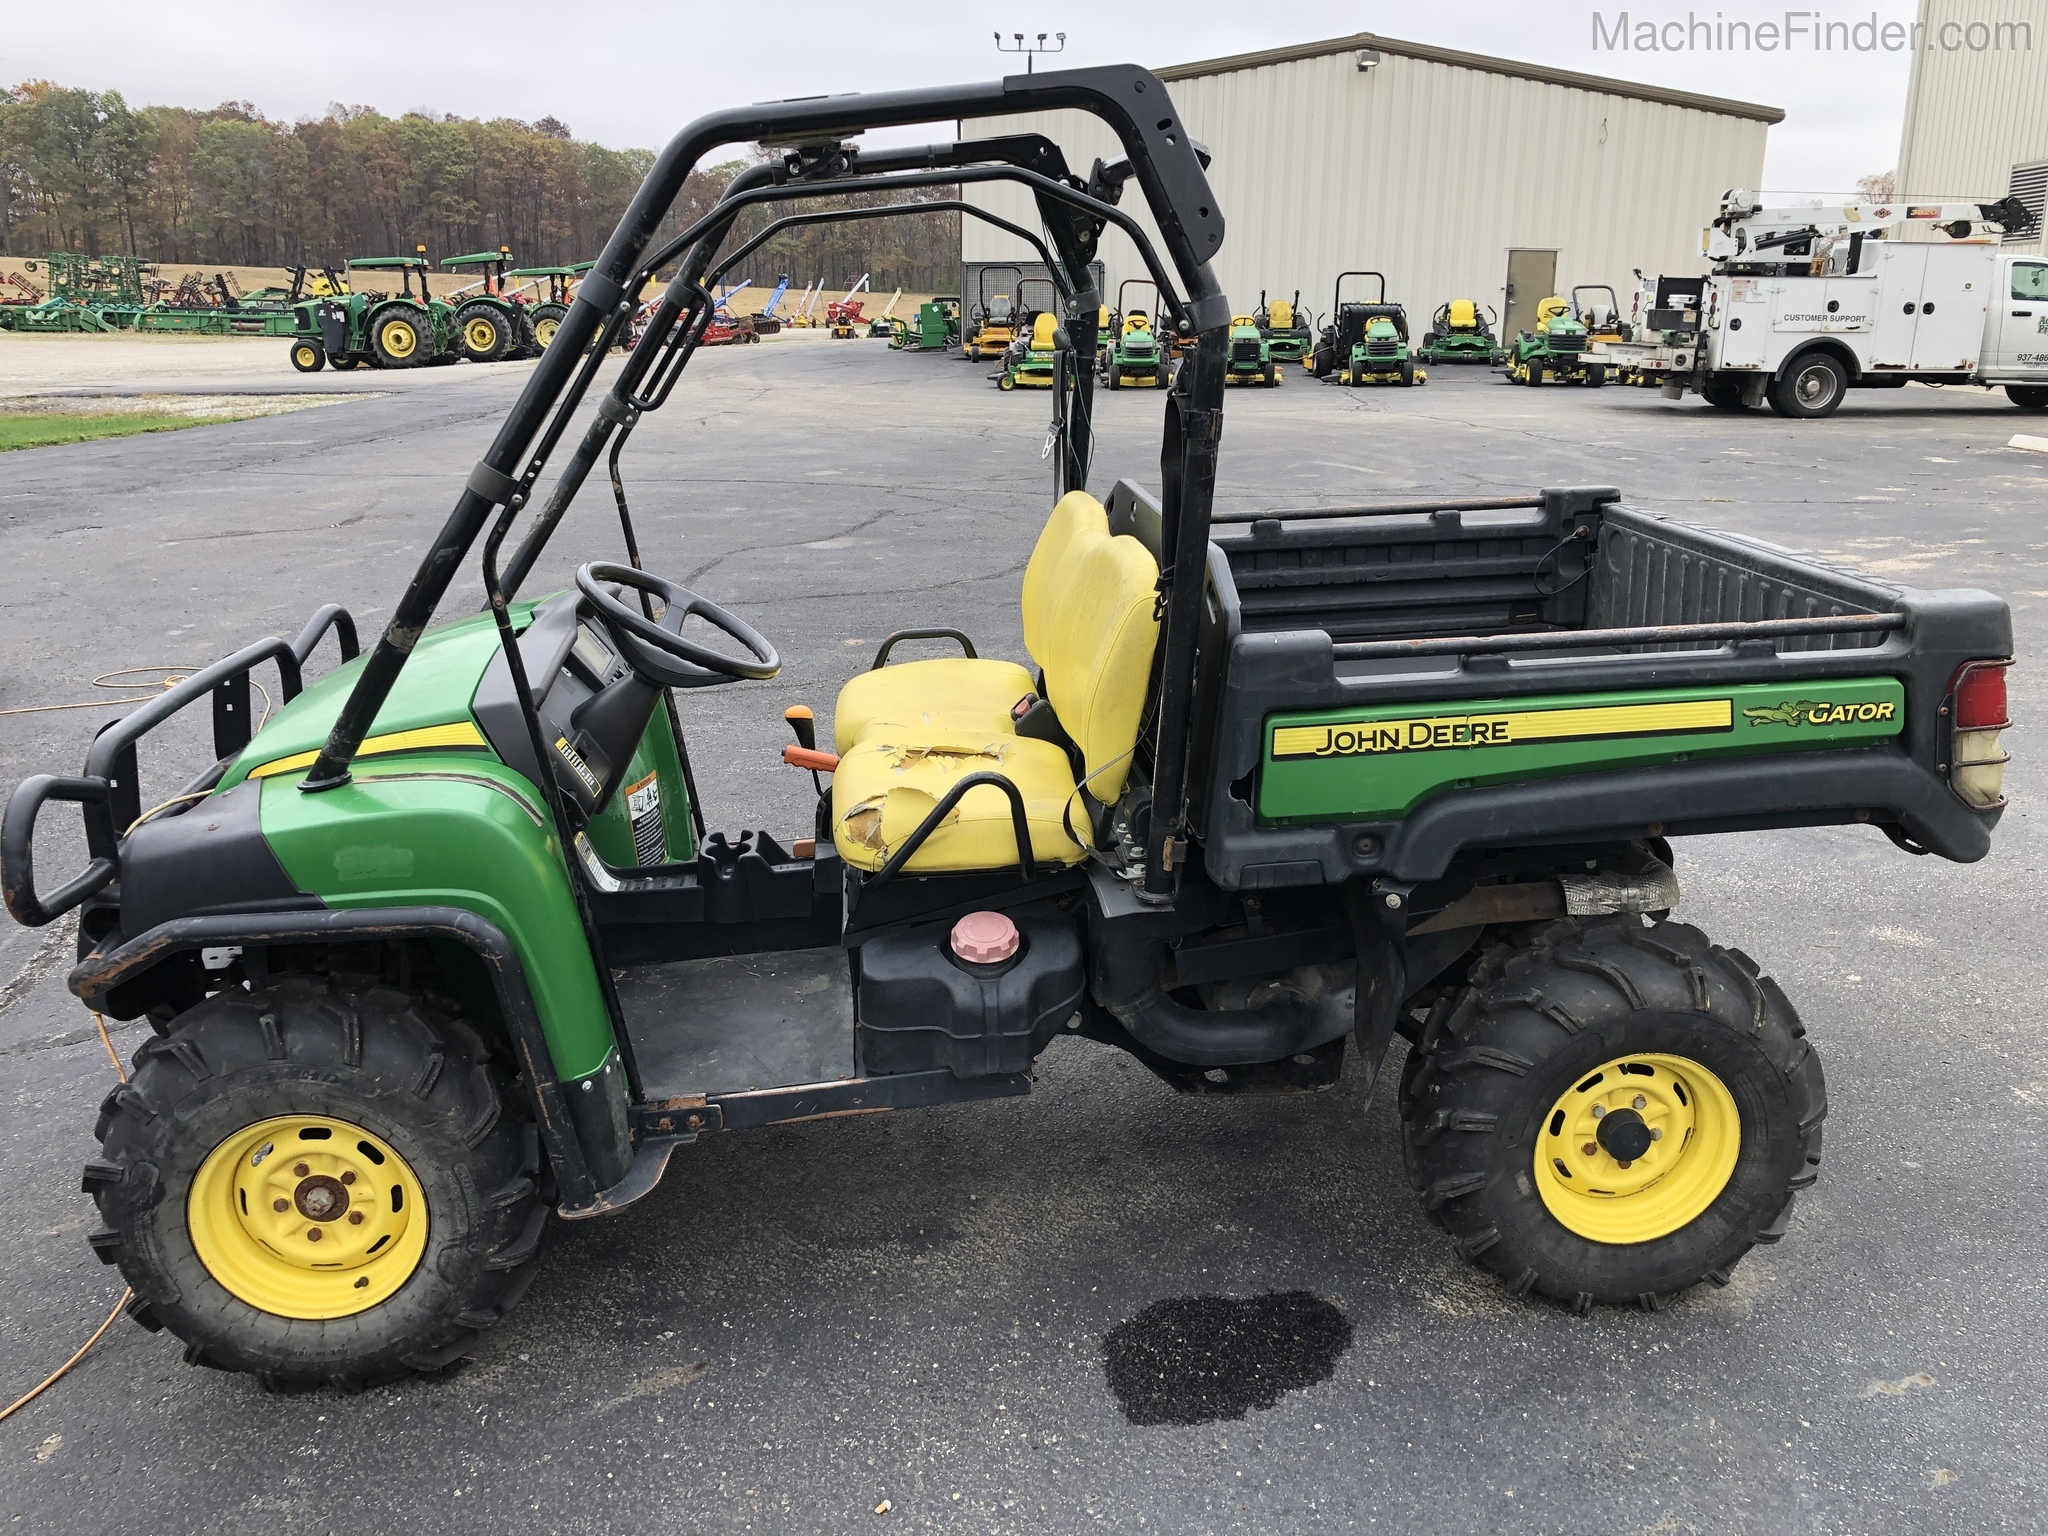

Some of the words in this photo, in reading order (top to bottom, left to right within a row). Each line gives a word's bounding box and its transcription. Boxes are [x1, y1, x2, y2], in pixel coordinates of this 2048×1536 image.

[1783, 314, 1828, 322] CUSTOMER
[1829, 315, 1866, 323] SUPPORT
[1807, 702, 1895, 724] GATOR
[1315, 728, 1402, 753] JOHN
[1408, 721, 1510, 747] DEERE
